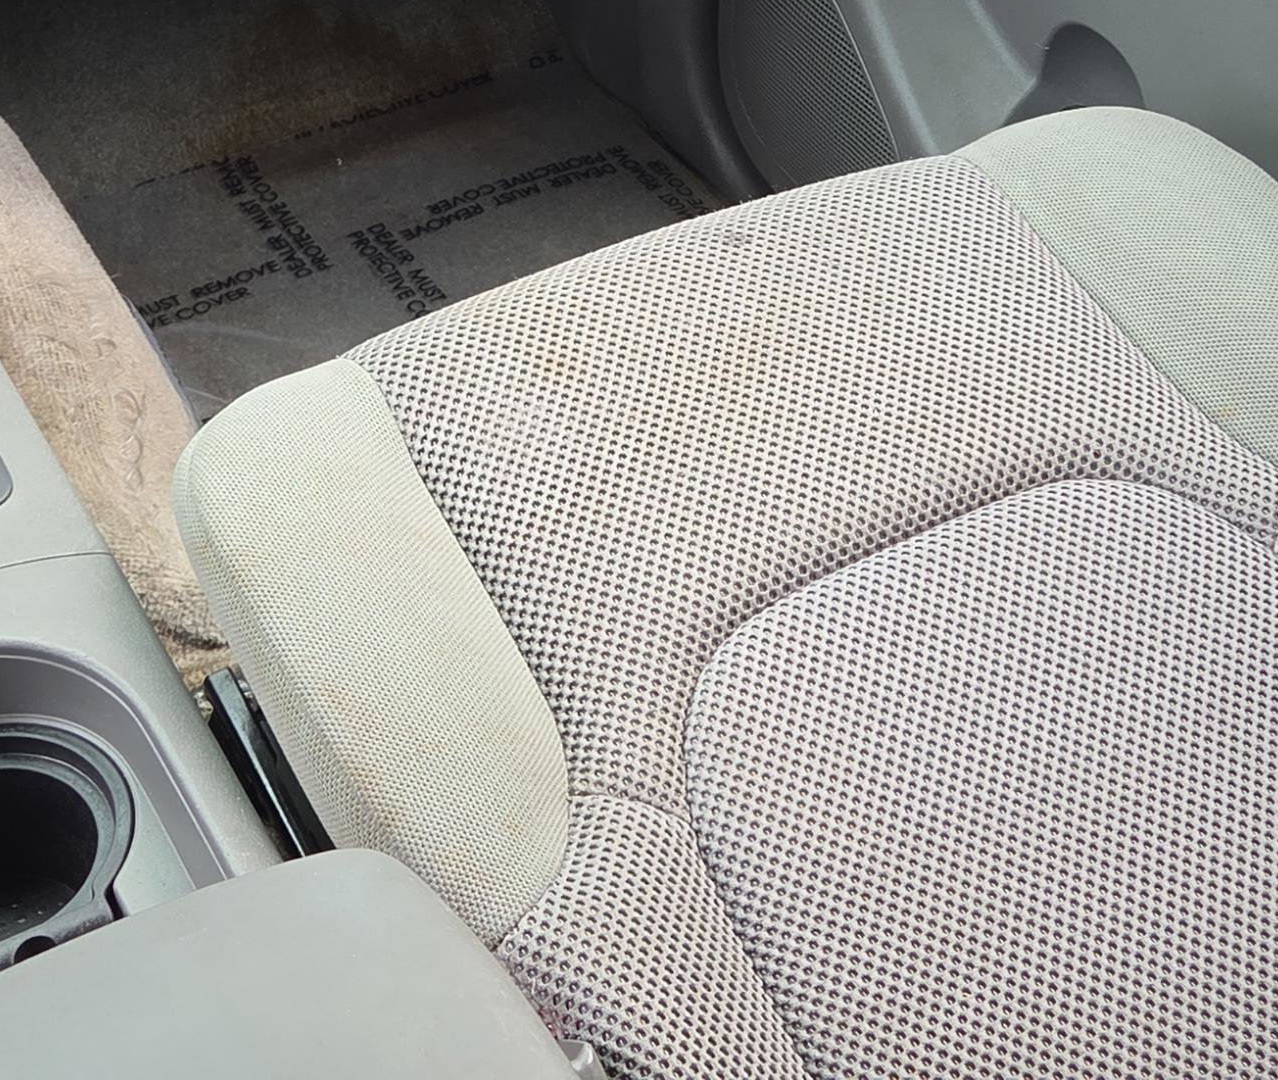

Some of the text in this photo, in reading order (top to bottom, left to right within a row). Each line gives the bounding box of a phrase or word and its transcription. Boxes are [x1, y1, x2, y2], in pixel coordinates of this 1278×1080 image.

[399, 162, 618, 241] DEALER MUST REMOVE
[426, 151, 607, 216] PROTECTIVE COVER
[190, 260, 282, 298] REMOVE
[346, 229, 412, 302] PROTECTIVE
[366, 222, 416, 266] DEALER
[406, 267, 447, 303] MUST
[175, 286, 252, 321] COVER
